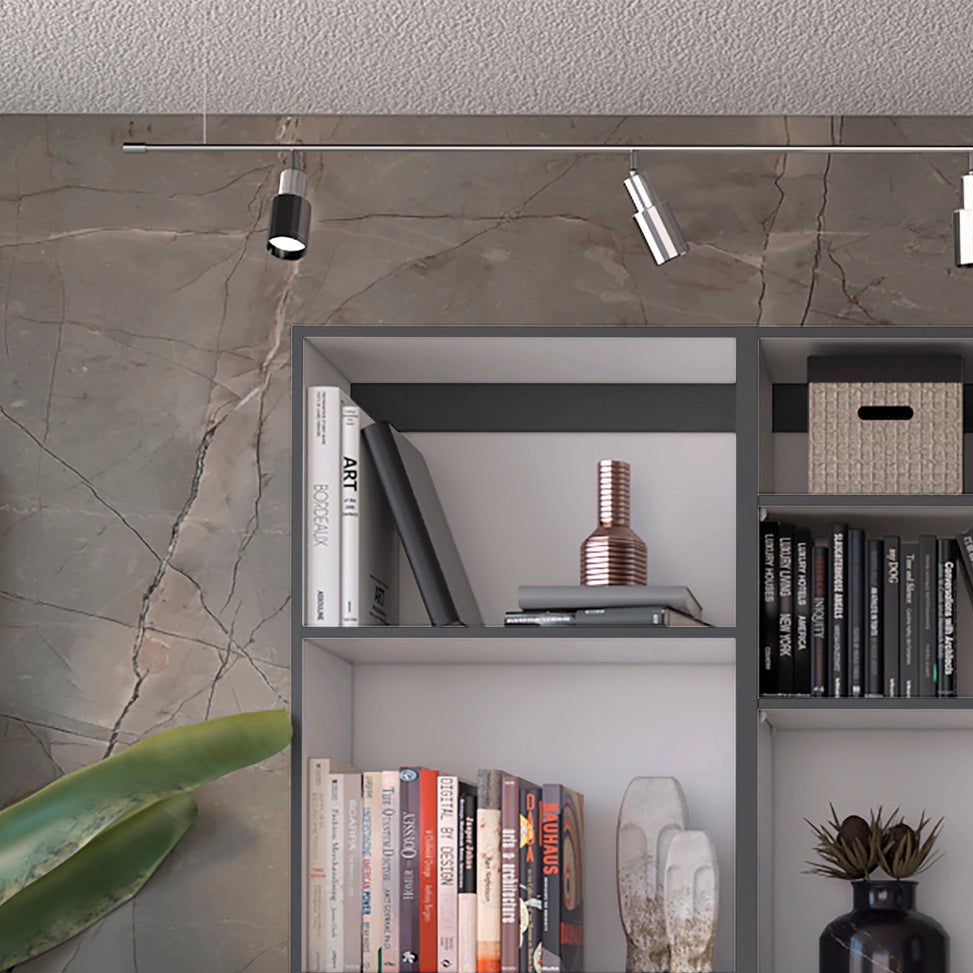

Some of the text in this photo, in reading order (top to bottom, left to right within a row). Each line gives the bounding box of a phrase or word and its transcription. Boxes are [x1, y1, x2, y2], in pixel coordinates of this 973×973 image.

[343, 456, 358, 492] ART
[313, 484, 329, 548] BORDEAUX
[765, 534, 774, 602] LUXURY HOUSES
[888, 561, 898, 583] DOG
[906, 570, 914, 582] and
[780, 537, 791, 656] LUXURY LIVING NEW YORK
[797, 542, 806, 650] LUXURY HOTELS AMERICA
[812, 597, 824, 639] INIQUITY
[834, 593, 843, 619] ANGELS
[944, 561, 954, 675] Conversations with Architects
[349, 799, 357, 851] SCARPA
[382, 808, 395, 848] QUANTUM
[402, 812, 417, 859] ODYSSEY
[440, 778, 453, 886] DIGITAL BY DESIGN
[465, 817, 474, 870] Jasper Johns
[502, 829, 516, 848] arts
[542, 803, 559, 875] BAUHAUS
[363, 859, 371, 889] AMERICAN
[382, 849, 395, 882] DOCTOR
[363, 891, 371, 915] POWER
[502, 864, 516, 923] architecture
